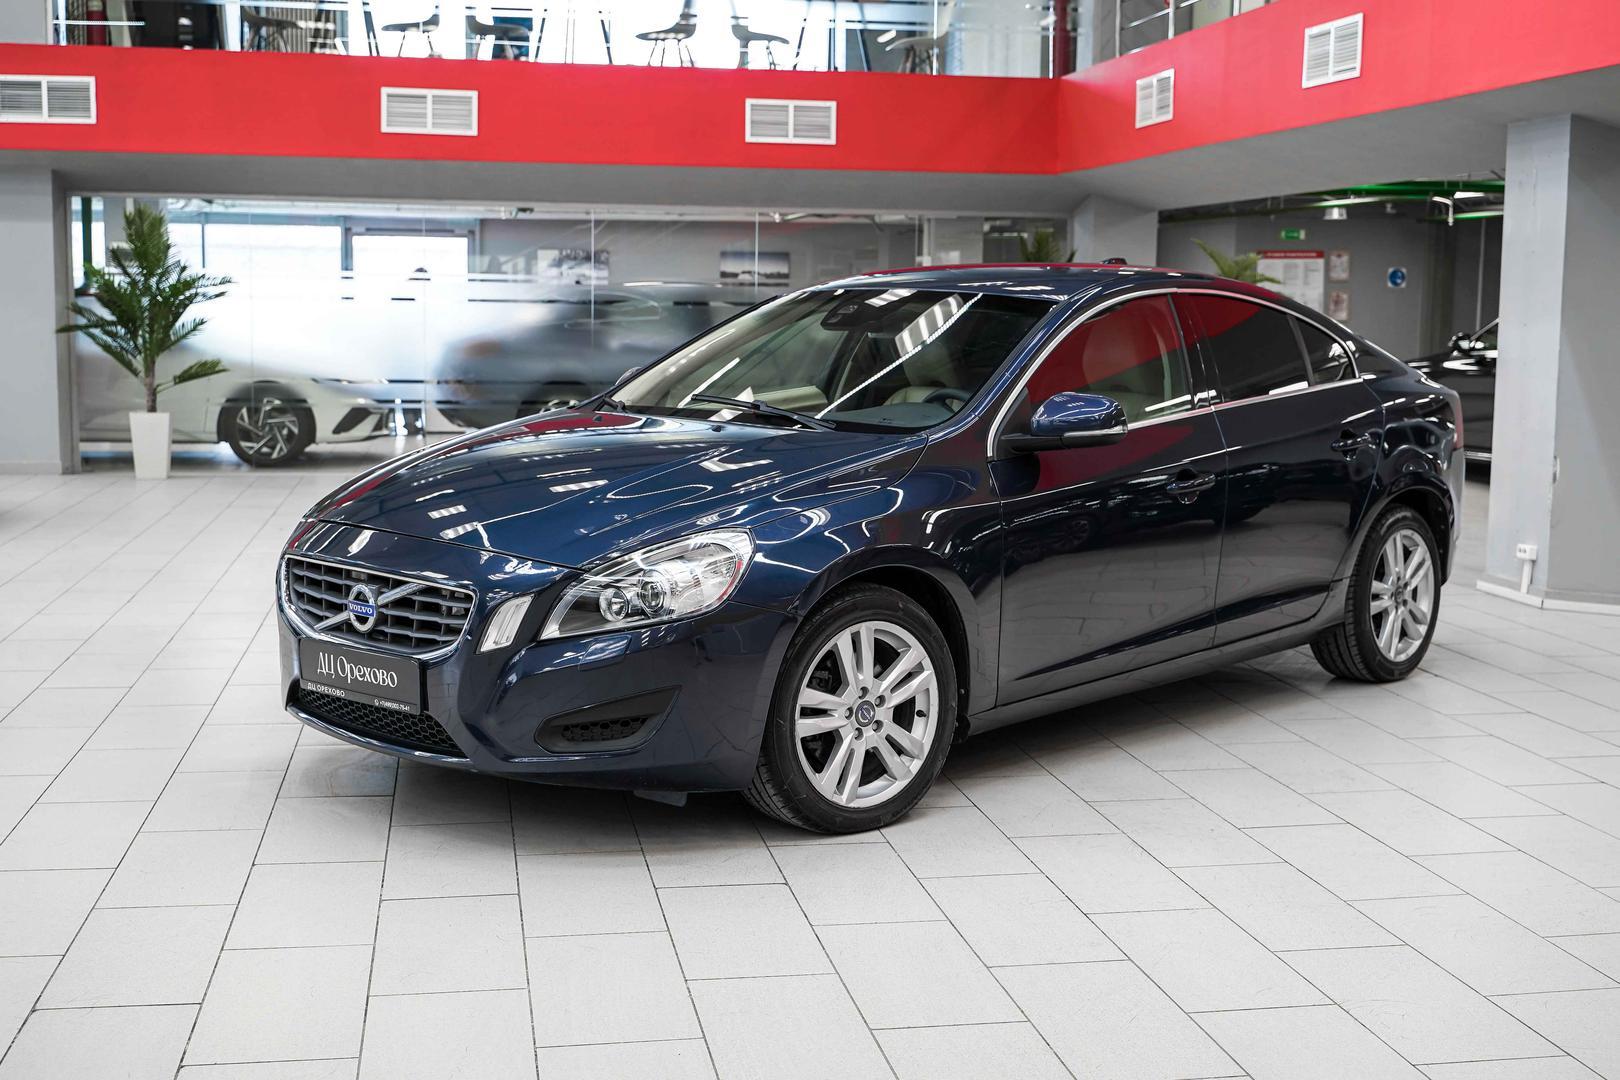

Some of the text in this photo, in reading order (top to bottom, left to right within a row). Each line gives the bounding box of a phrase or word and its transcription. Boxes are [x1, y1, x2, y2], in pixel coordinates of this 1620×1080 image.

[349, 602, 373, 614] VOLVO
[317, 652, 398, 688] ДЦ Орехово
[317, 685, 345, 697] ОРЕХОВО
